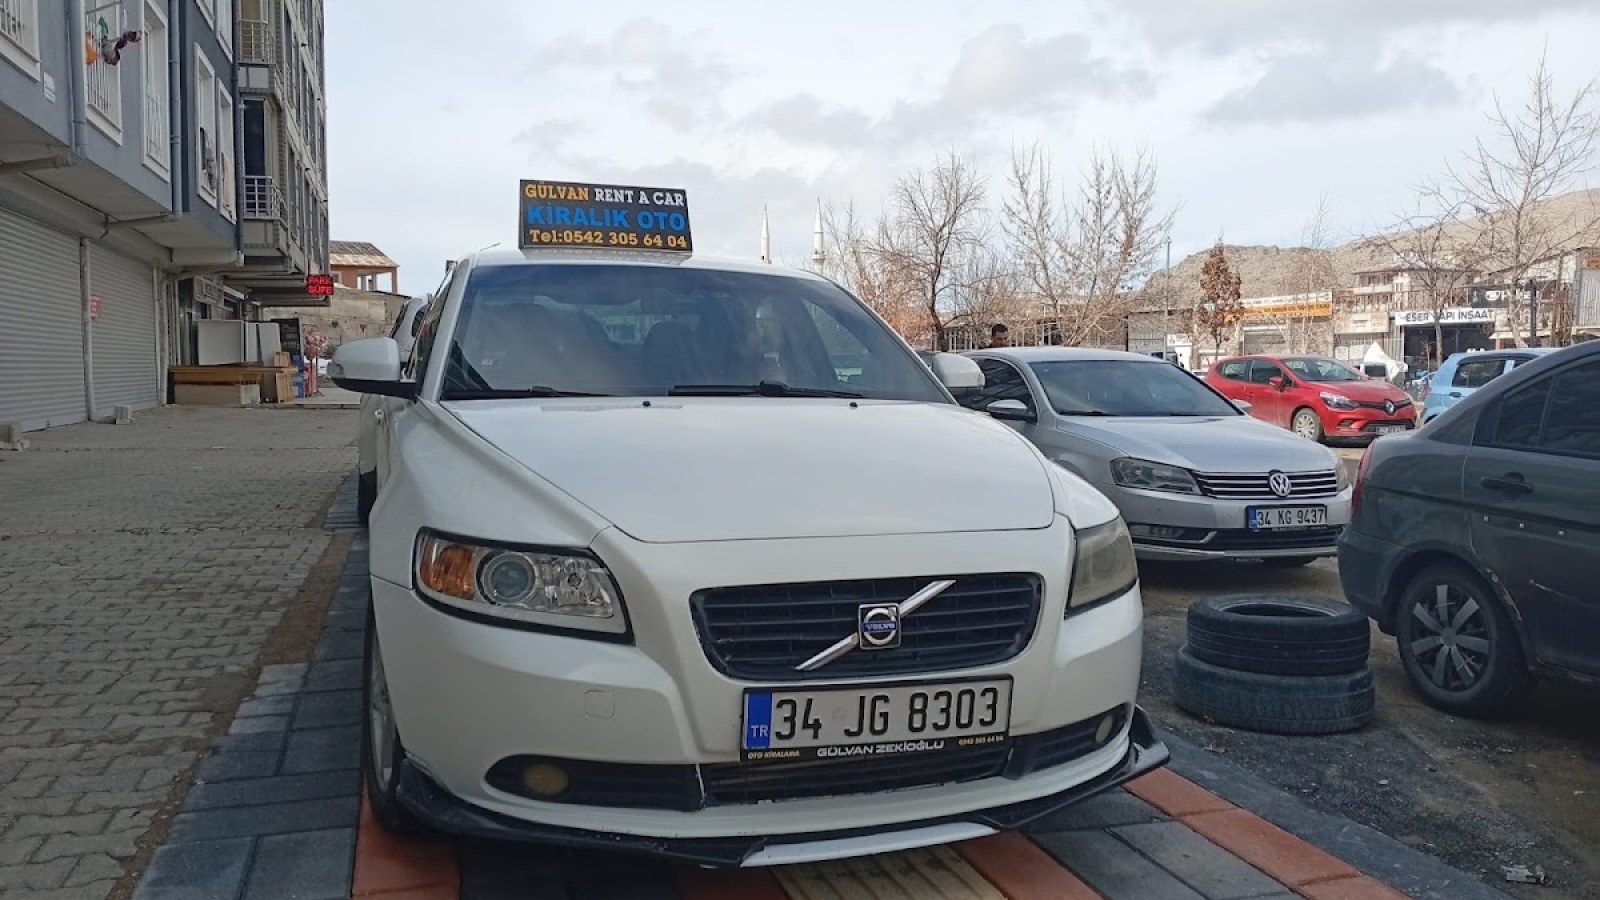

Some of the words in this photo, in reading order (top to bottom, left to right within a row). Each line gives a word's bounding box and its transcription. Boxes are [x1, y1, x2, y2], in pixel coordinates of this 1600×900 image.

[525, 181, 589, 201] GÜLVAN
[594, 188, 634, 203] RENT
[639, 190, 650, 204] A
[653, 192, 685, 207] CAR
[527, 202, 630, 228] KİRALIK
[638, 211, 686, 232] OTO
[529, 229, 604, 244] Tel:0542
[609, 232, 638, 245] 305
[643, 234, 663, 247] 64
[667, 235, 687, 248] 04
[1406, 312, 1429, 322] ESER
[1257, 511, 1271, 526] 34
[1278, 510, 1292, 525] KG
[1297, 508, 1324, 524] 9437
[775, 697, 822, 740] 34
[844, 694, 890, 737] JG
[908, 687, 998, 733] 8303
[751, 724, 768, 737] TR
[817, 744, 874, 757] GÜLVAN
